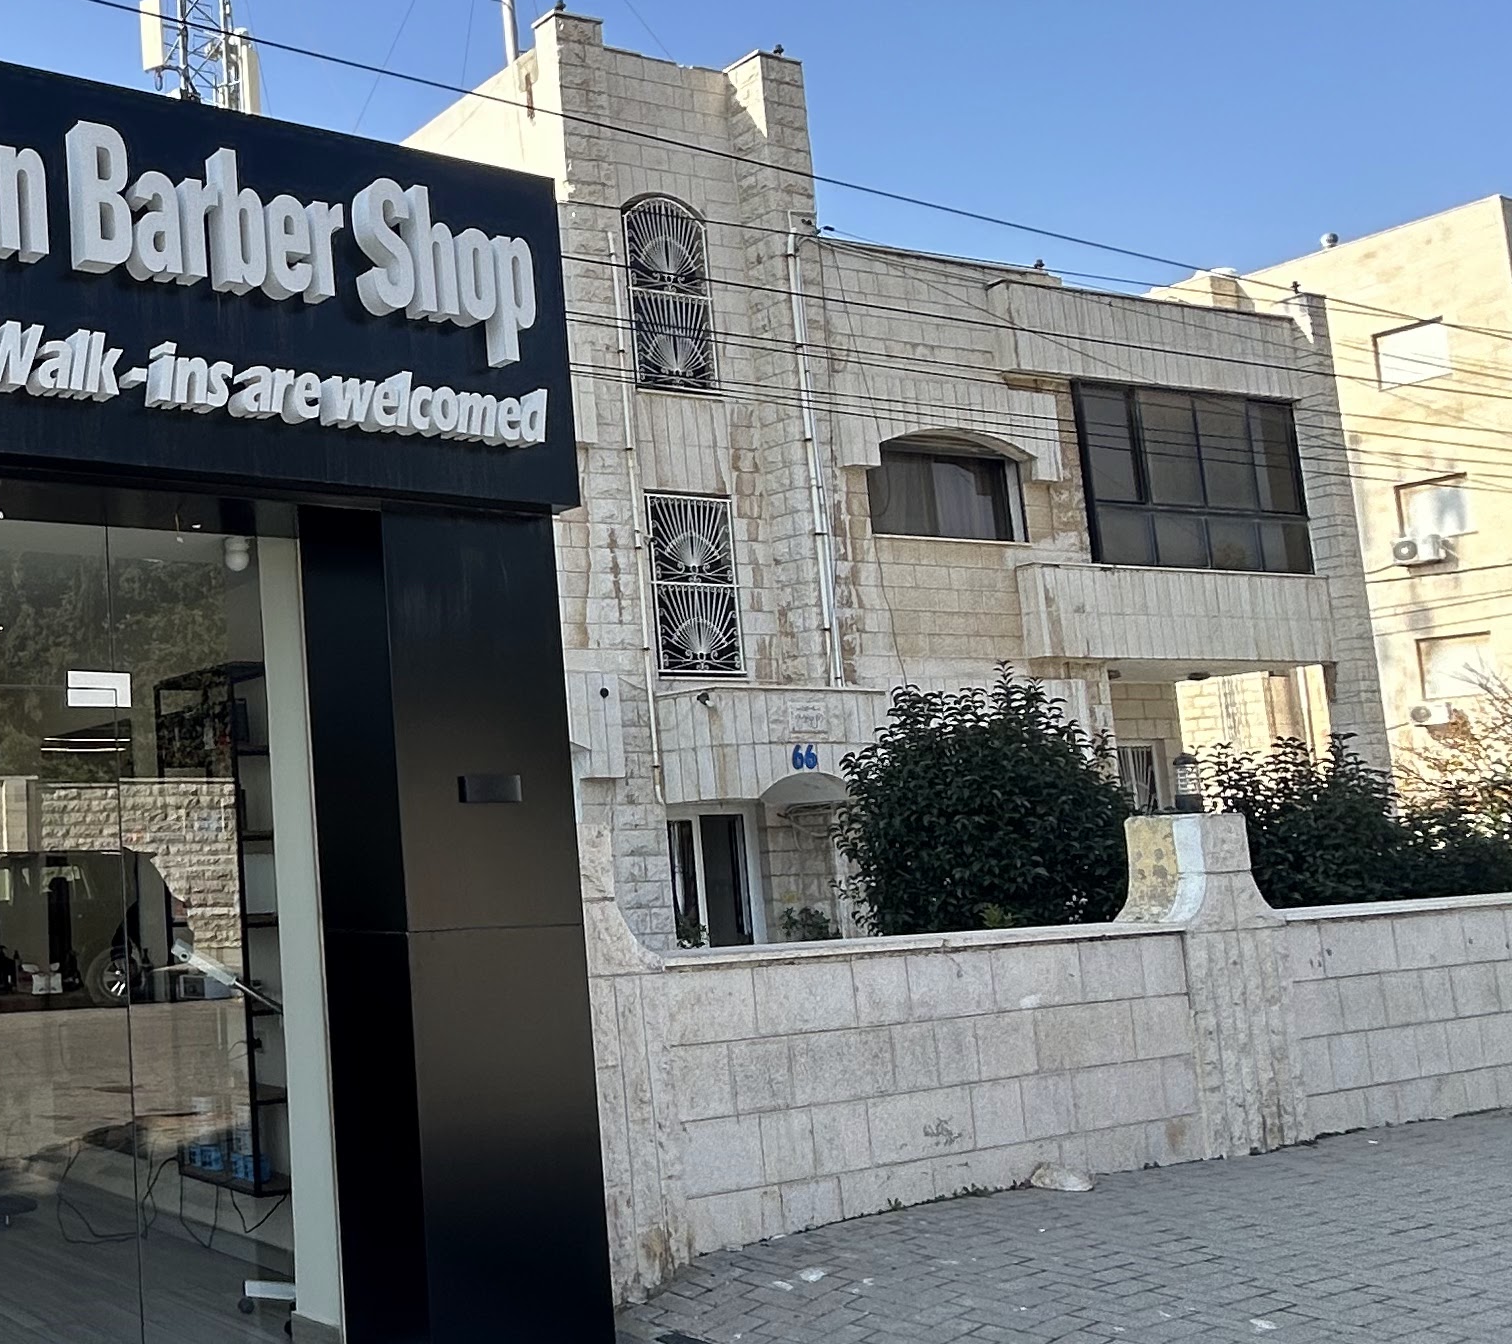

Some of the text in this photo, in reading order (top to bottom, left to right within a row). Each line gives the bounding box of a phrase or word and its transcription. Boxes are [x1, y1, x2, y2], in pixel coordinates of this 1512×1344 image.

[65, 120, 344, 305] Barber
[352, 177, 537, 369] Shop
[228, 363, 322, 424] are
[320, 370, 548, 449] welcomed
[792, 744, 818, 770] 66
